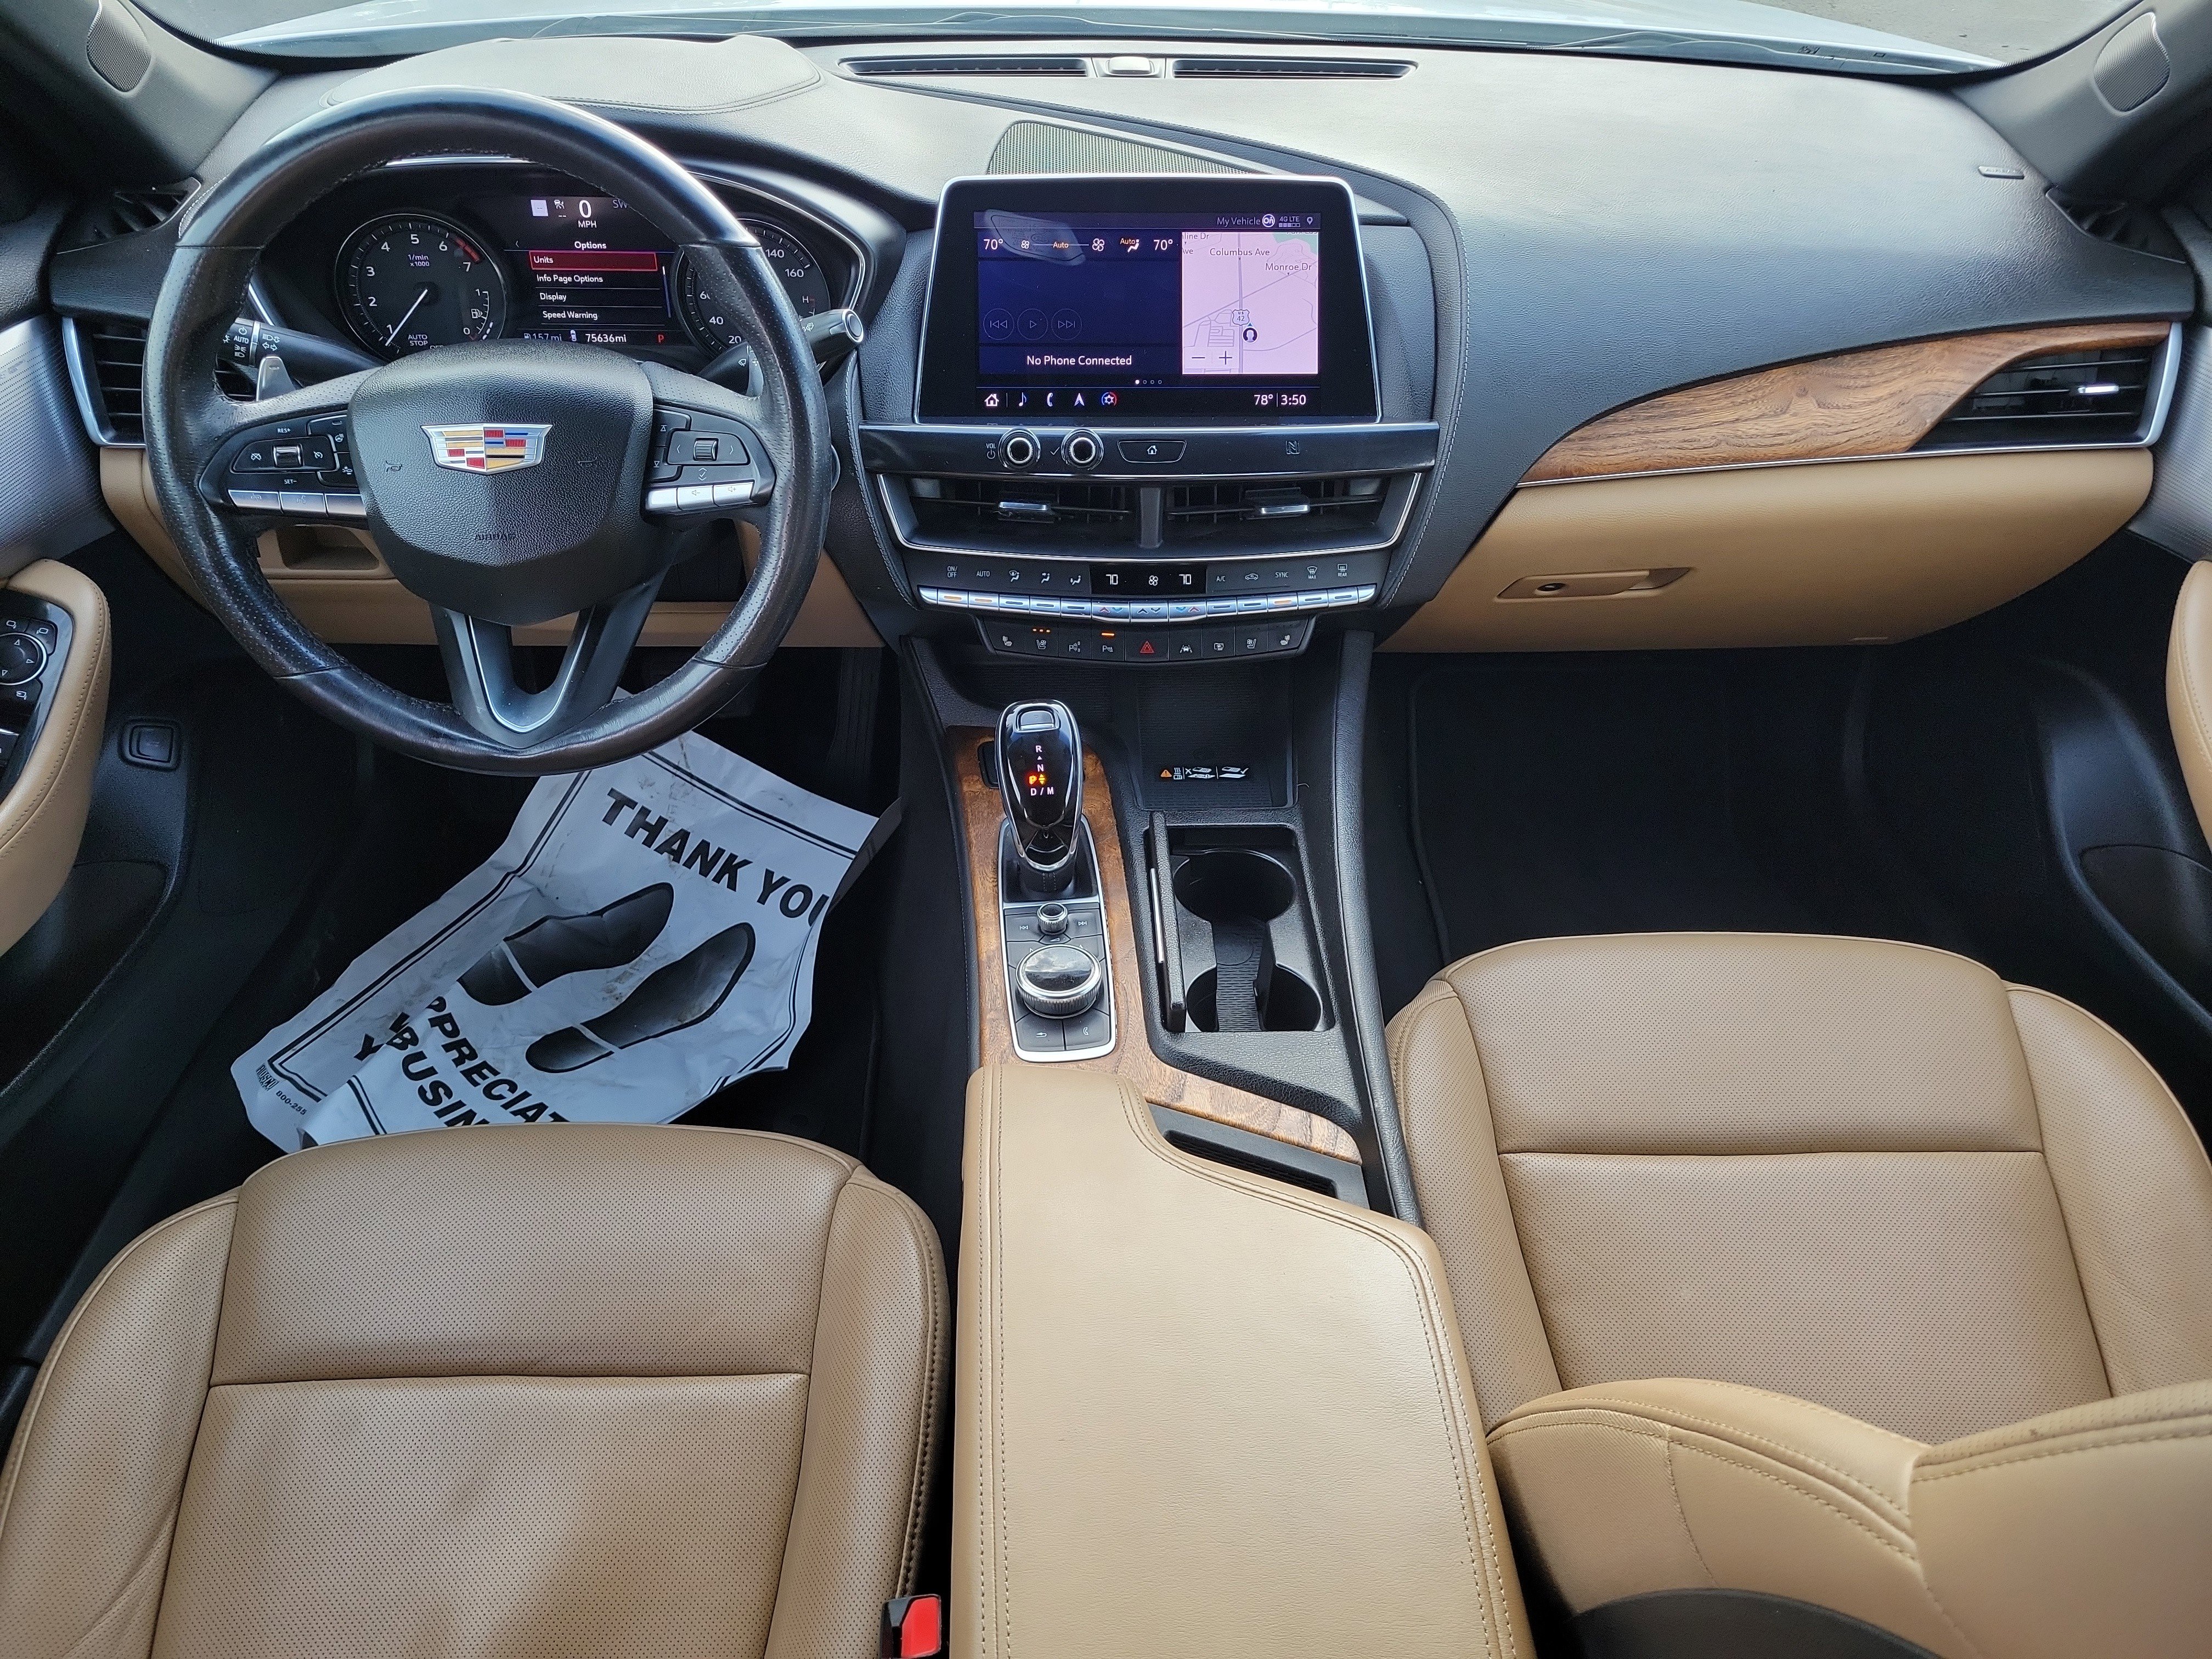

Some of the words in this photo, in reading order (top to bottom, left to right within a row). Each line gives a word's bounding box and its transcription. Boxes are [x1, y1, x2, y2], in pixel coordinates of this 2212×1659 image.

[578, 200, 592, 218] 0
[1217, 217, 1229, 227] My
[1231, 217, 1261, 225] Vehicle
[410, 234, 419, 244] 5
[381, 241, 391, 251] 4
[439, 241, 448, 251] 6
[574, 241, 607, 250] Options
[983, 239, 1003, 250] 70°
[1153, 239, 1173, 250] 70°
[765, 249, 785, 258] 140
[1210, 248, 1253, 256] Columbus
[1255, 248, 1270, 256] Ave
[366, 267, 375, 276] 3
[462, 262, 471, 272] 7
[1265, 263, 1299, 271] Monroe
[1302, 263, 1312, 271] Dr
[785, 269, 804, 278] 160
[537, 274, 551, 282] Info
[553, 274, 572, 284] Page
[574, 275, 603, 284] Options
[368, 297, 377, 307] 2
[539, 292, 567, 302] Display
[543, 311, 566, 320] Speed
[567, 311, 598, 320] Warning
[709, 317, 724, 325] 40
[386, 324, 394, 334] 1
[234, 335, 249, 344] AUTO
[658, 334, 664, 343] P
[728, 335, 742, 344] 20
[1026, 356, 1041, 365] No
[1044, 356, 1076, 365] Phone
[1078, 356, 1132, 365] Connected
[1254, 393, 1273, 405] 78°
[1280, 394, 1306, 405] 3:50
[1105, 574, 1119, 585] 70
[1178, 574, 1192, 585] 70
[1037, 764, 1044, 772] N
[602, 787, 753, 892] THANK
